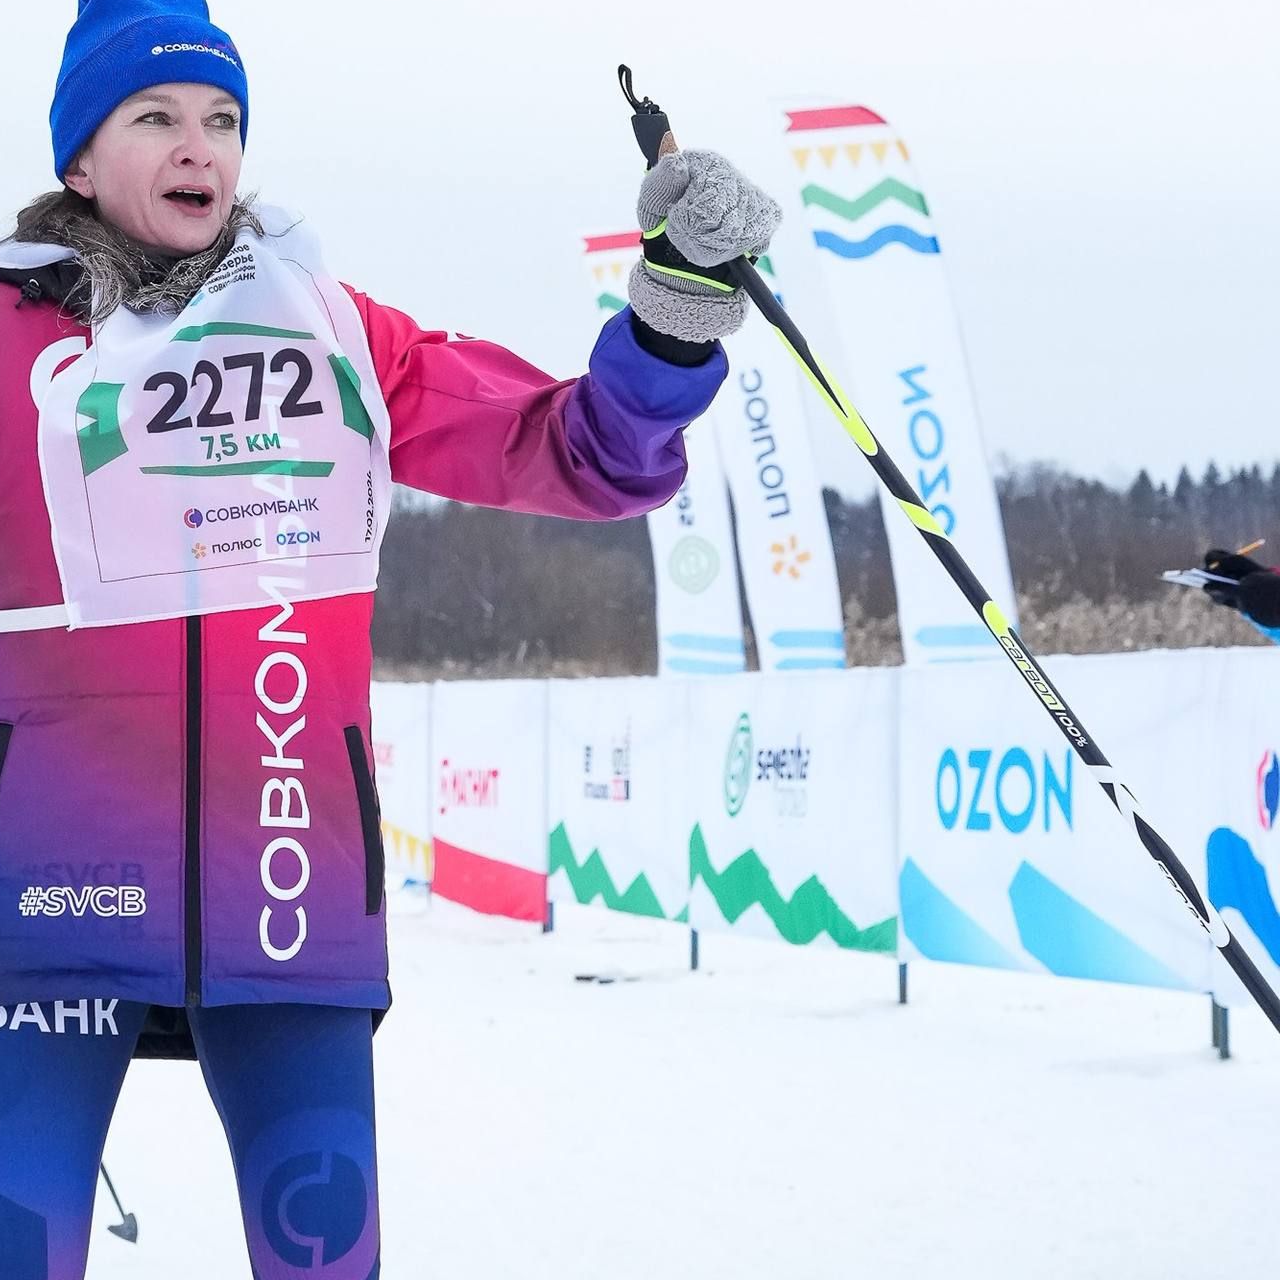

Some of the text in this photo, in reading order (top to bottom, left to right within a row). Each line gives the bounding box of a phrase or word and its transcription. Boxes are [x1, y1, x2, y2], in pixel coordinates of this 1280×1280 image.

[143, 348, 323, 433] 2272
[200, 433, 239, 462] 7,5
[206, 498, 320, 523] СОВКОМБАНК
[212, 538, 263, 554] ПОЛЮС
[276, 530, 321, 546] OZON
[1055, 710, 1088, 748] 100%
[936, 746, 1074, 834] OZON
[18, 886, 147, 917] #SVCB
